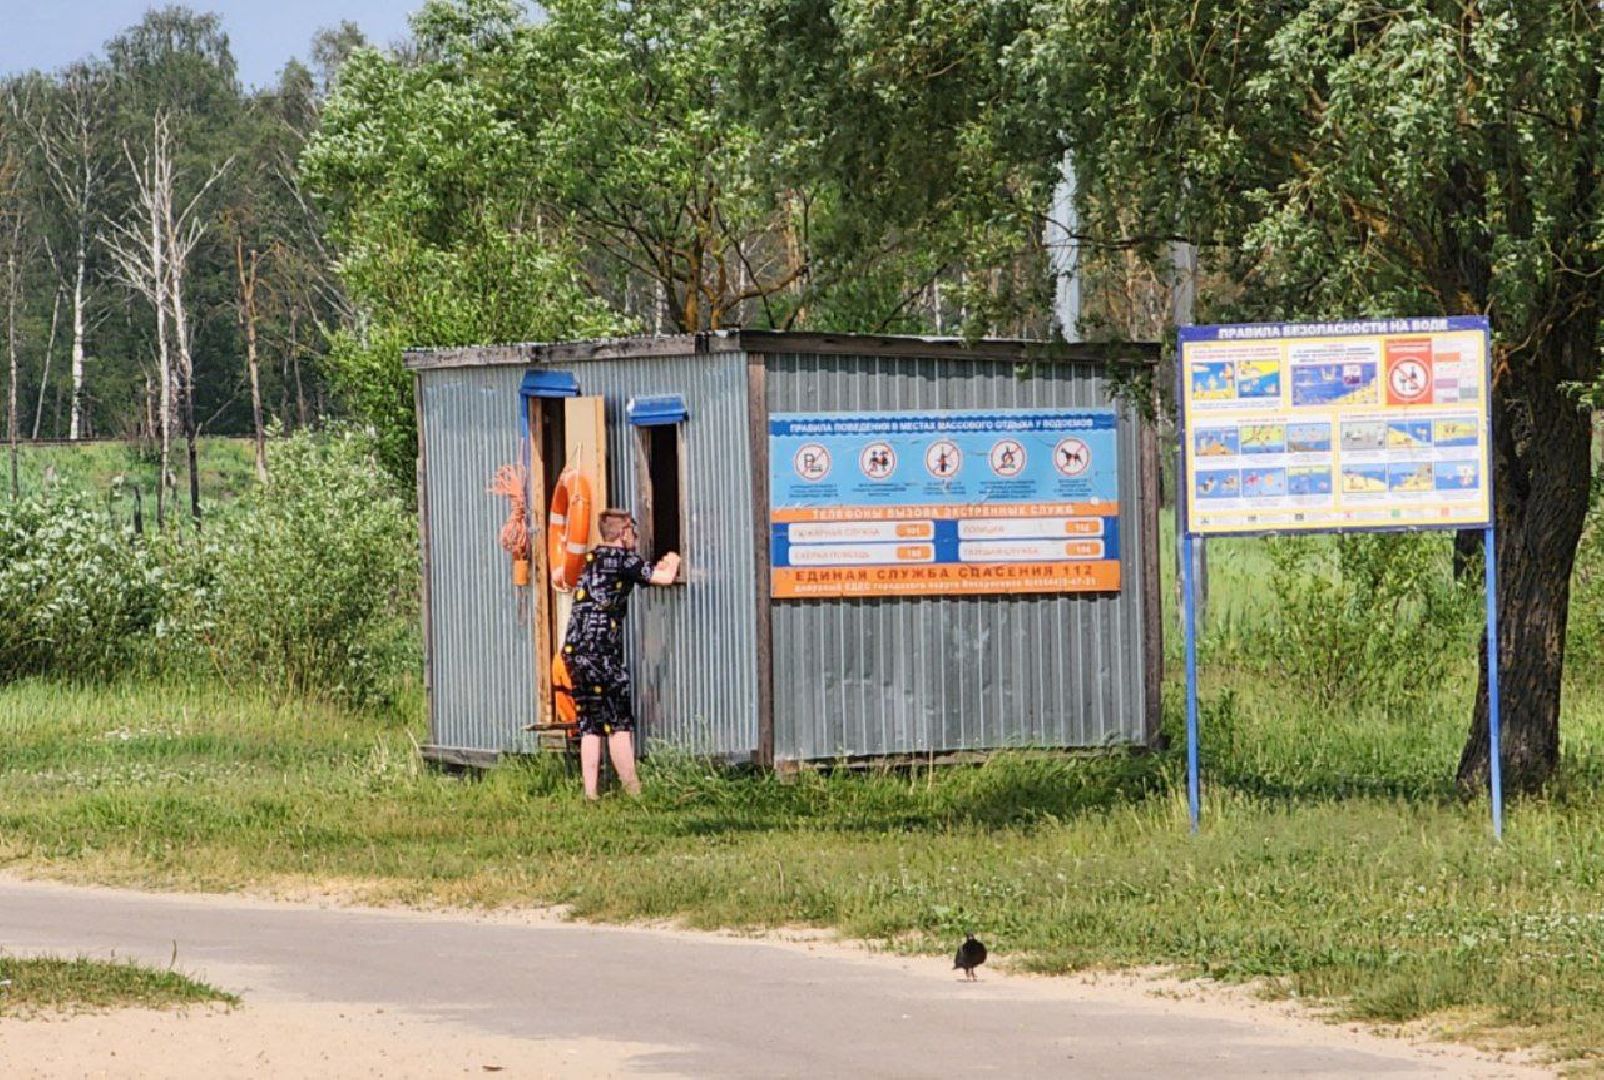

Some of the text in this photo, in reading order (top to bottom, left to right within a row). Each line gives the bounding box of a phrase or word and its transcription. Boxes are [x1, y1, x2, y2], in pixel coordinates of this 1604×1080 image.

[1218, 319, 1448, 339] ПРАВИЛА БЕЗОПАСНОСТИ НА ВОДЕ
[812, 509, 881, 520] ТЕЛЕФОНЫ
[887, 507, 939, 518] ВЫЗОВА
[795, 565, 1092, 583] ЕДИНАЯ СЛУЖБА СПАСЕНИЯ 112
